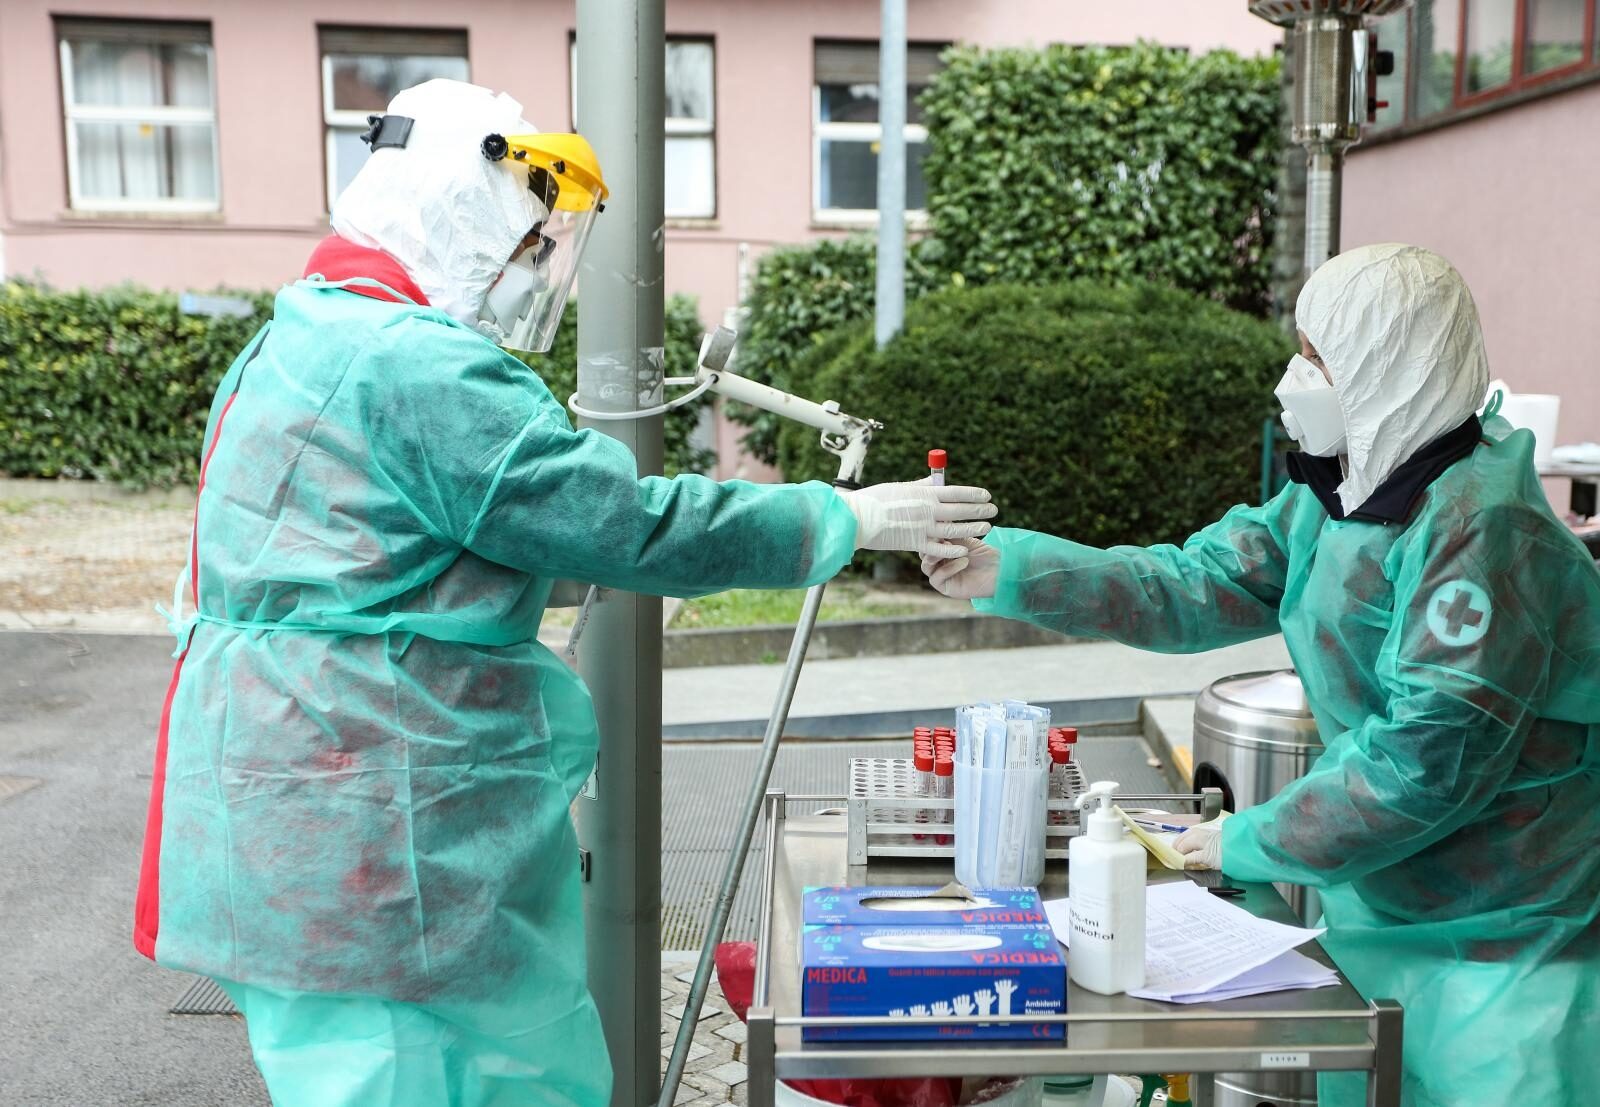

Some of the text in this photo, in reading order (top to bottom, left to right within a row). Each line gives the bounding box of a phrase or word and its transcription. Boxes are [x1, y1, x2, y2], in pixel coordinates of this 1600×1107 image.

[961, 912, 1043, 922] MEDICA
[1074, 925, 1114, 940] alkohol
[972, 952, 1059, 964] MEDICA
[808, 968, 867, 983] MEDICA
[1025, 1000, 1061, 1008] Ambidestri
